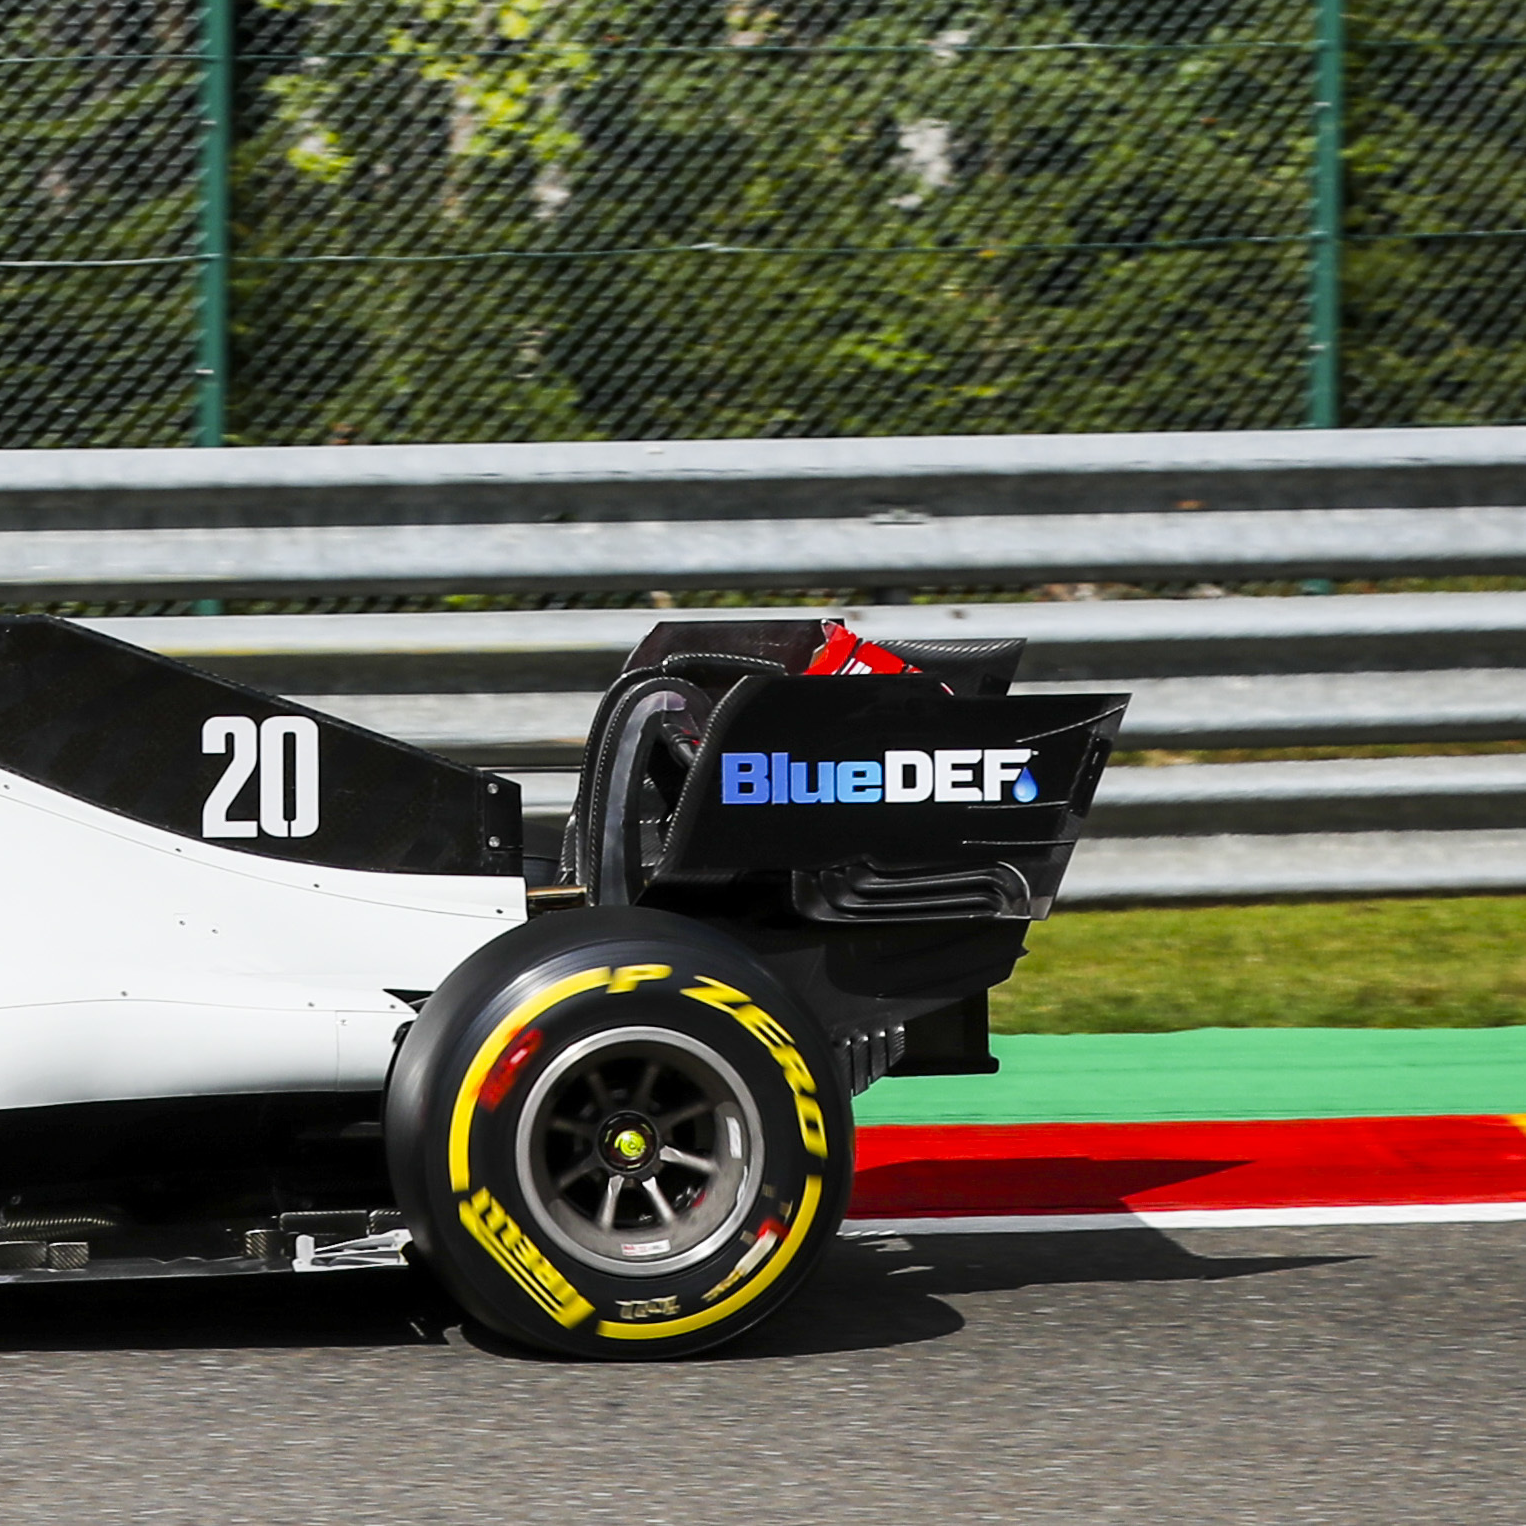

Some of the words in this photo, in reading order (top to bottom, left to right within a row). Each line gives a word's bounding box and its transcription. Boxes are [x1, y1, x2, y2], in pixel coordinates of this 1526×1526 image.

[201, 715, 319, 839] 20
[721, 749, 1031, 805] BlueDEF
[605, 964, 673, 994] P
[679, 975, 829, 1158] ZERO
